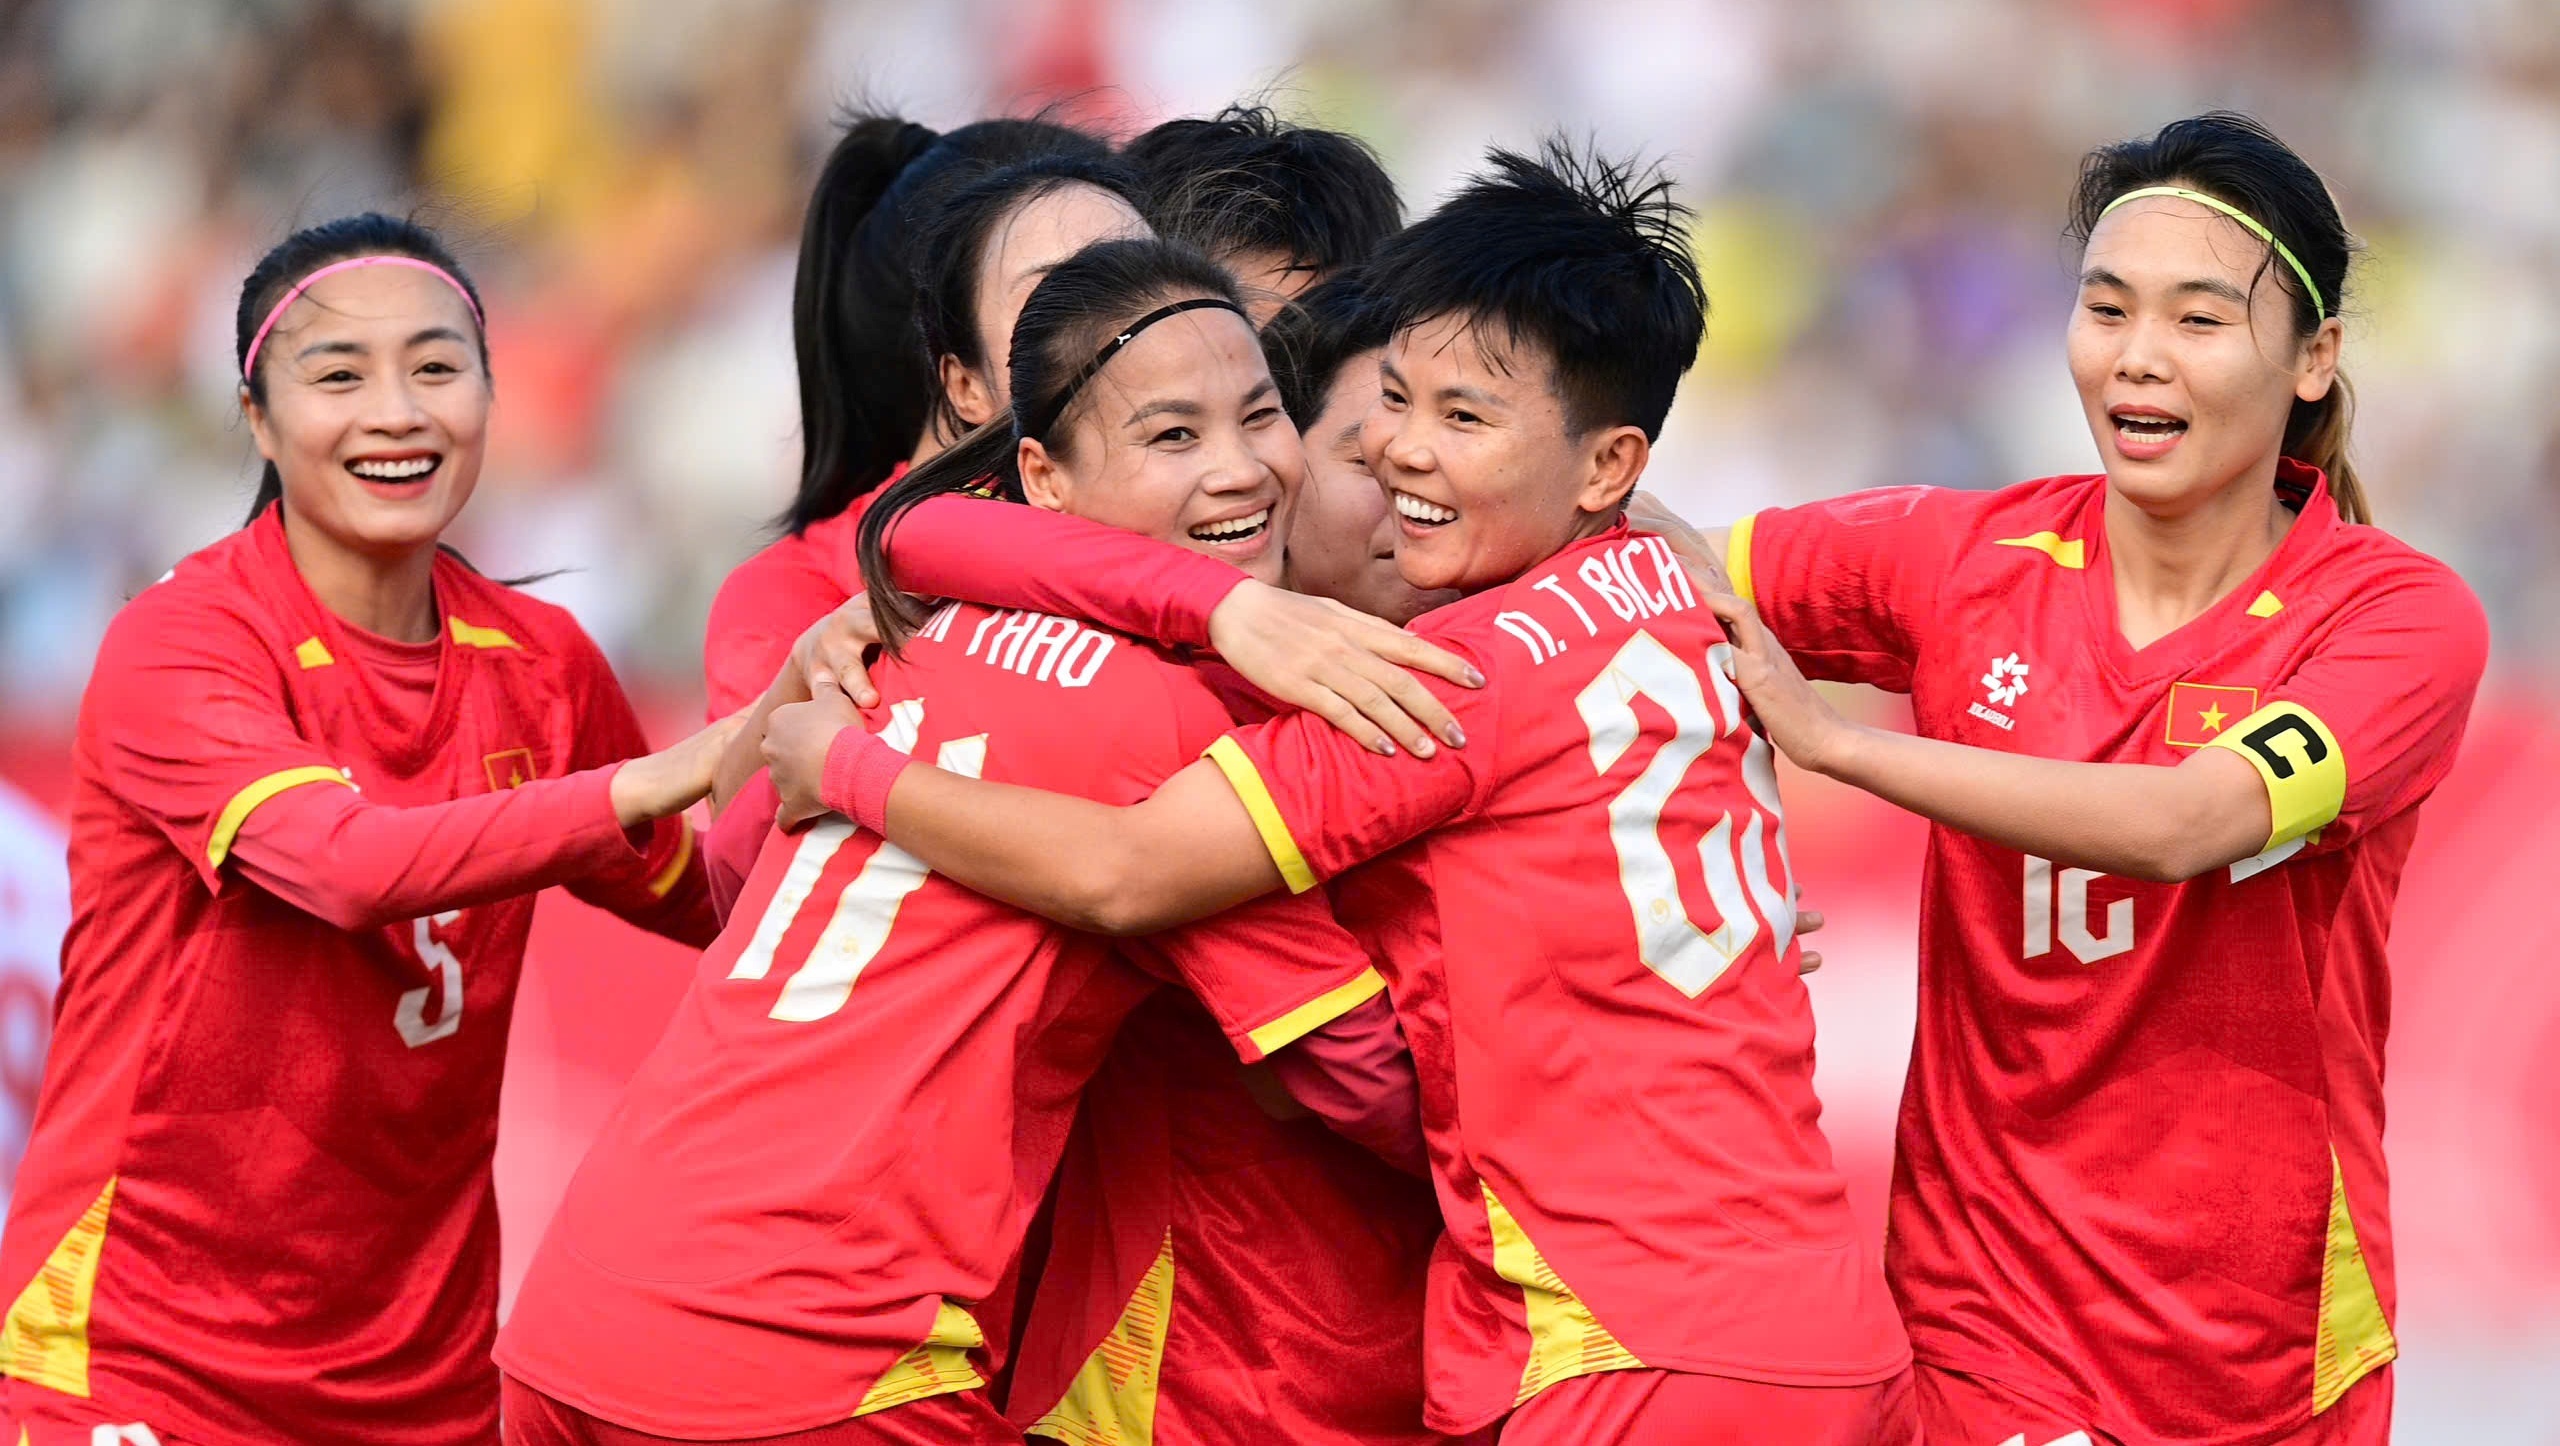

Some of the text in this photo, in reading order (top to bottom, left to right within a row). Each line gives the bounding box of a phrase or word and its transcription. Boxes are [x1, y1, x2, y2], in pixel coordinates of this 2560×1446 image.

[1531, 573, 1598, 638] T
[1577, 535, 1697, 623] BICH
[964, 607, 1117, 688] THAO
[2241, 713, 2328, 780] C
[726, 696, 989, 1023] 11
[392, 908, 464, 1049] 5
